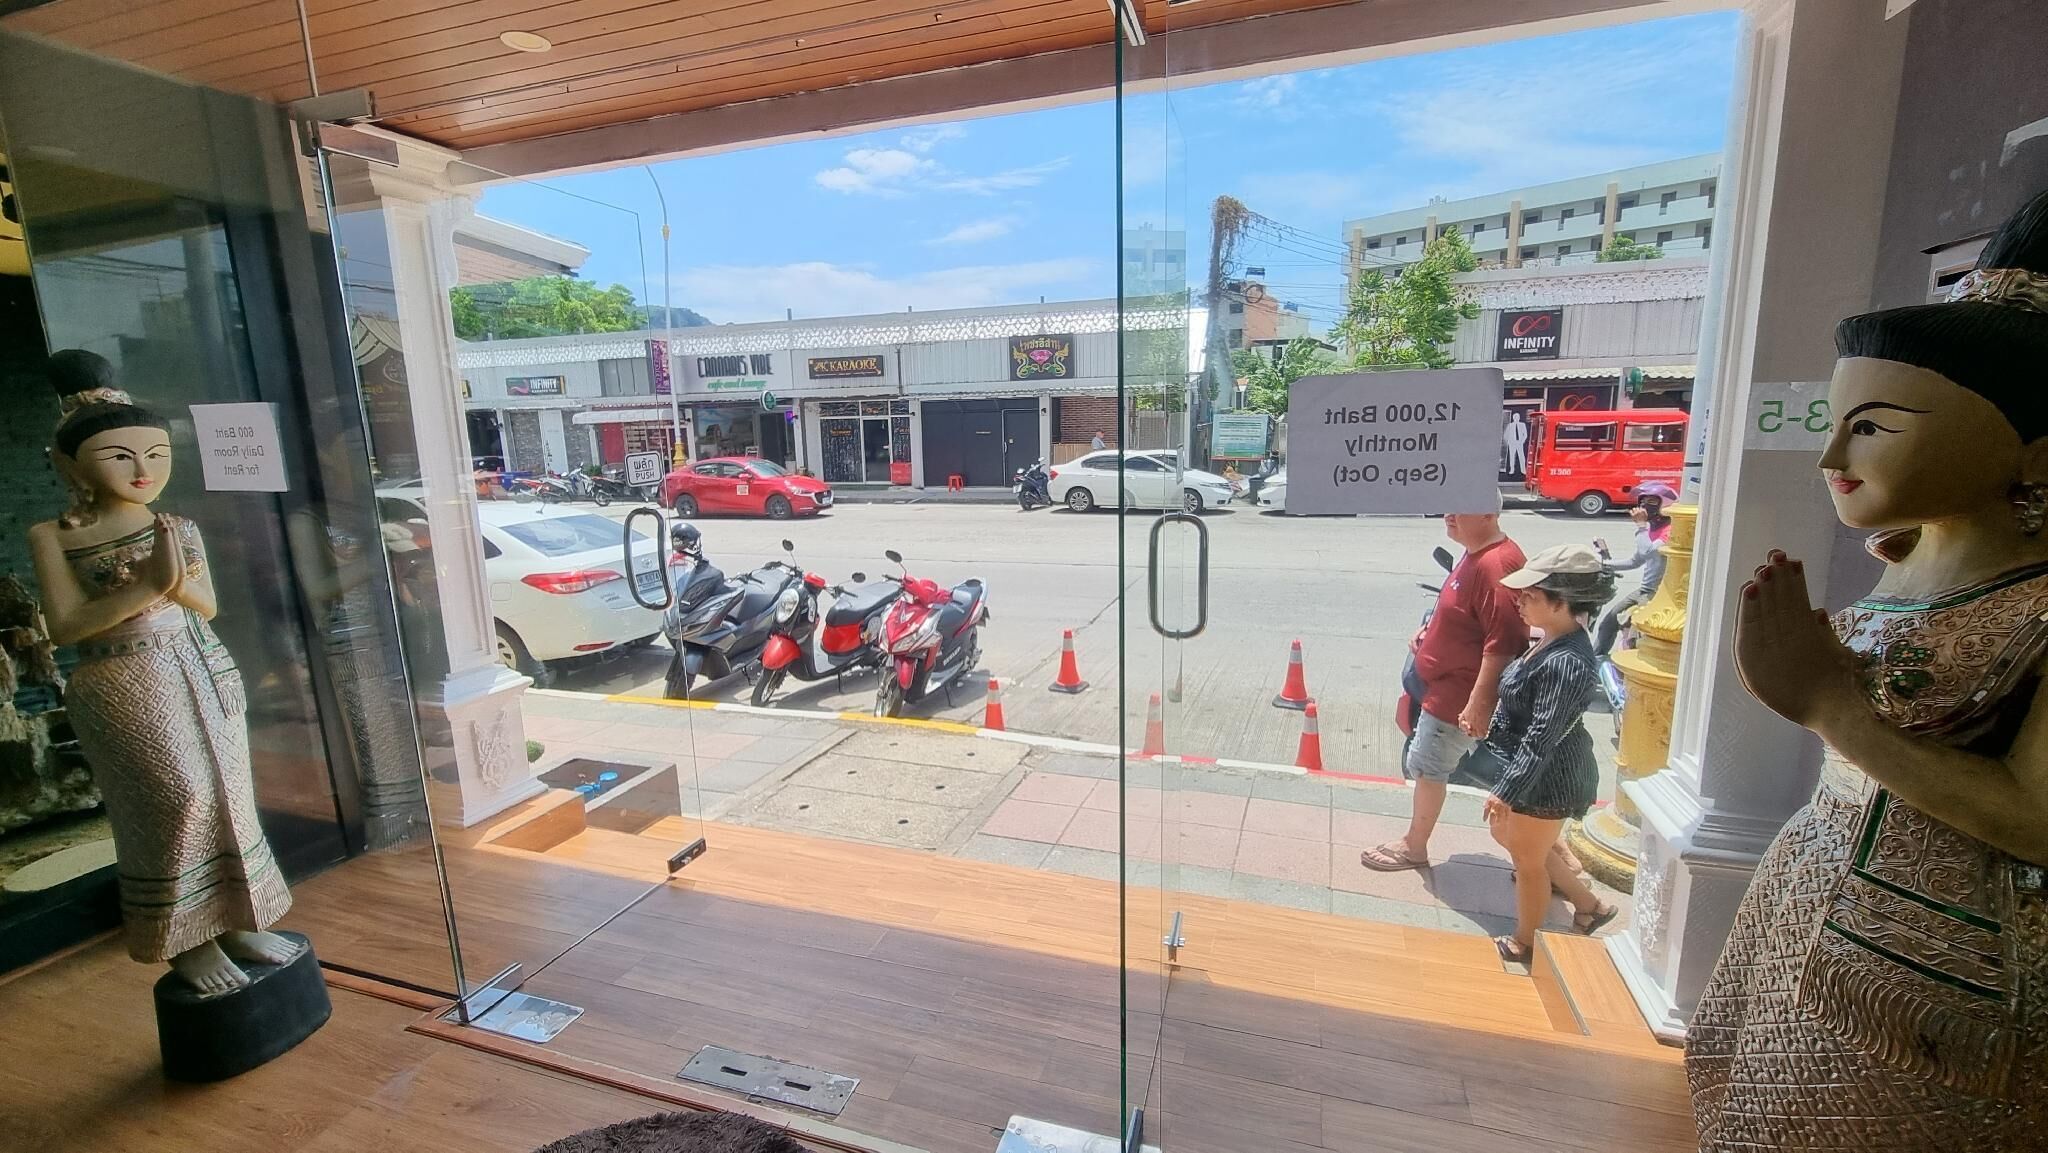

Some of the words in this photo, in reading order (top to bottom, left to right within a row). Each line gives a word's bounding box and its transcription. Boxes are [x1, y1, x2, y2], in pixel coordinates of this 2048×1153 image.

[1503, 336, 1556, 349] INFINITY
[829, 358, 877, 371] KARAOKE
[530, 378, 558, 389] INFINITY
[635, 471, 655, 480] PUSH
